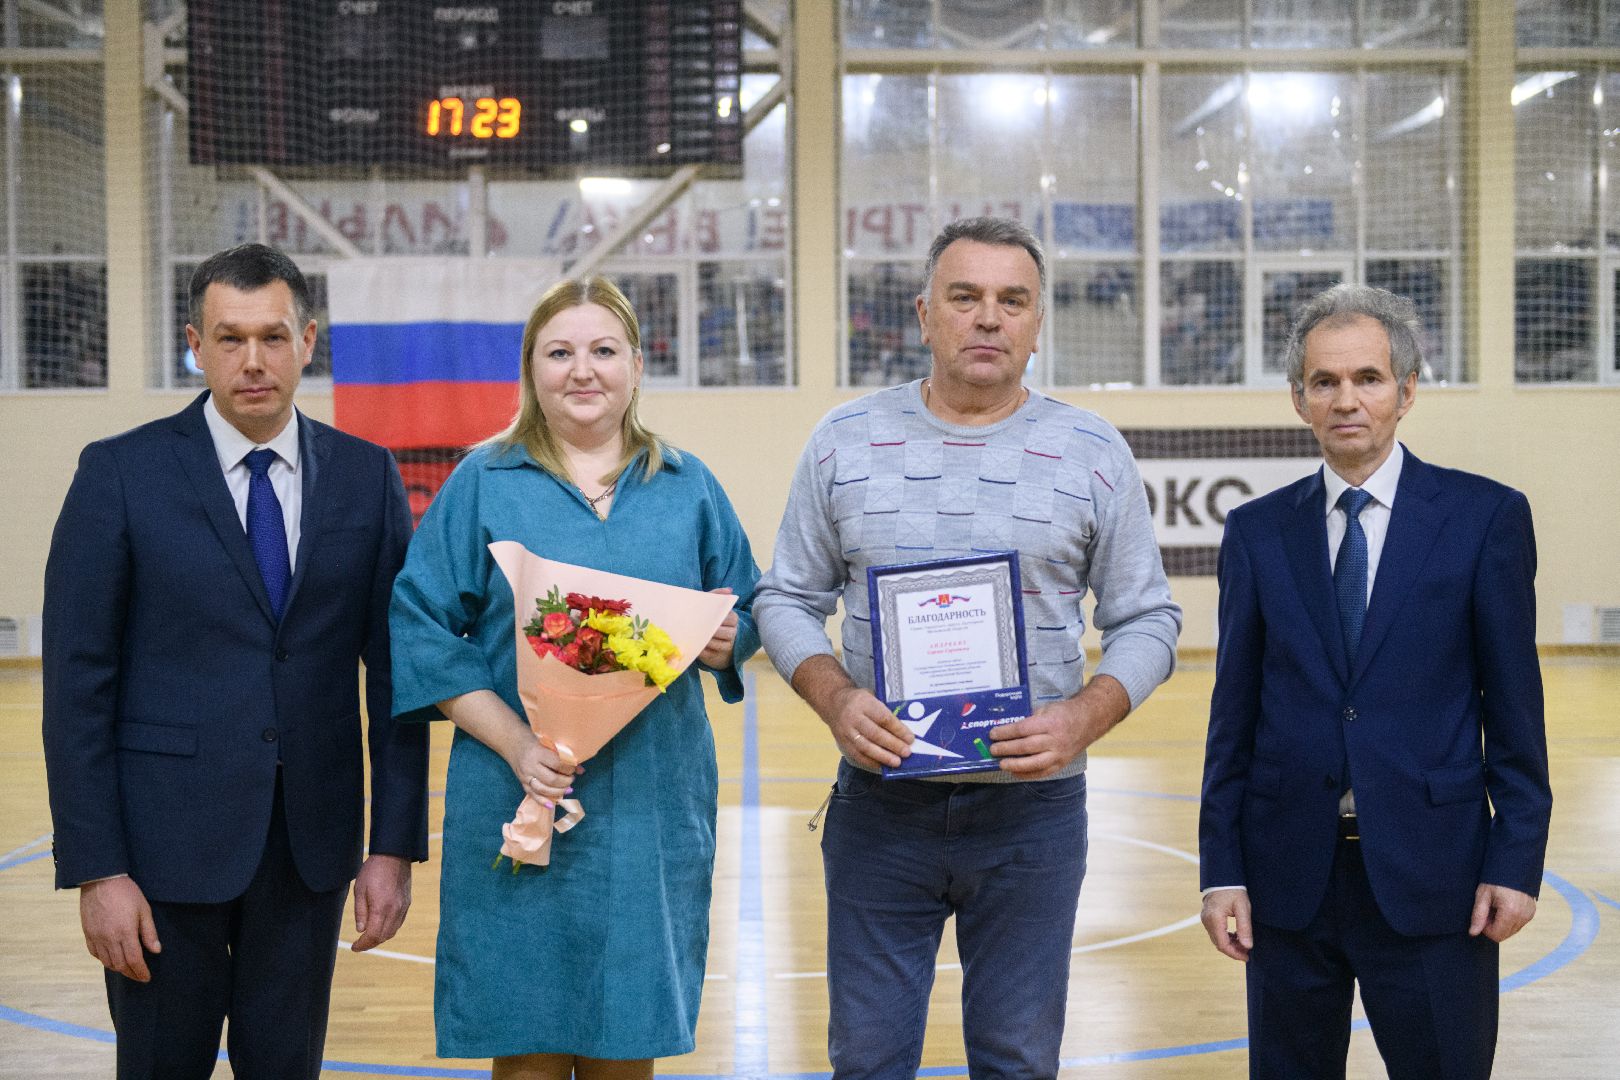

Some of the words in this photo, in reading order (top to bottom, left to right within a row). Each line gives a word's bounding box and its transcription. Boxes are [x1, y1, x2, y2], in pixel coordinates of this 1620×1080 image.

[427, 97, 464, 136] 17
[470, 97, 521, 138] 23
[908, 609, 986, 624] БЛАГОДАРНОСТЬ
